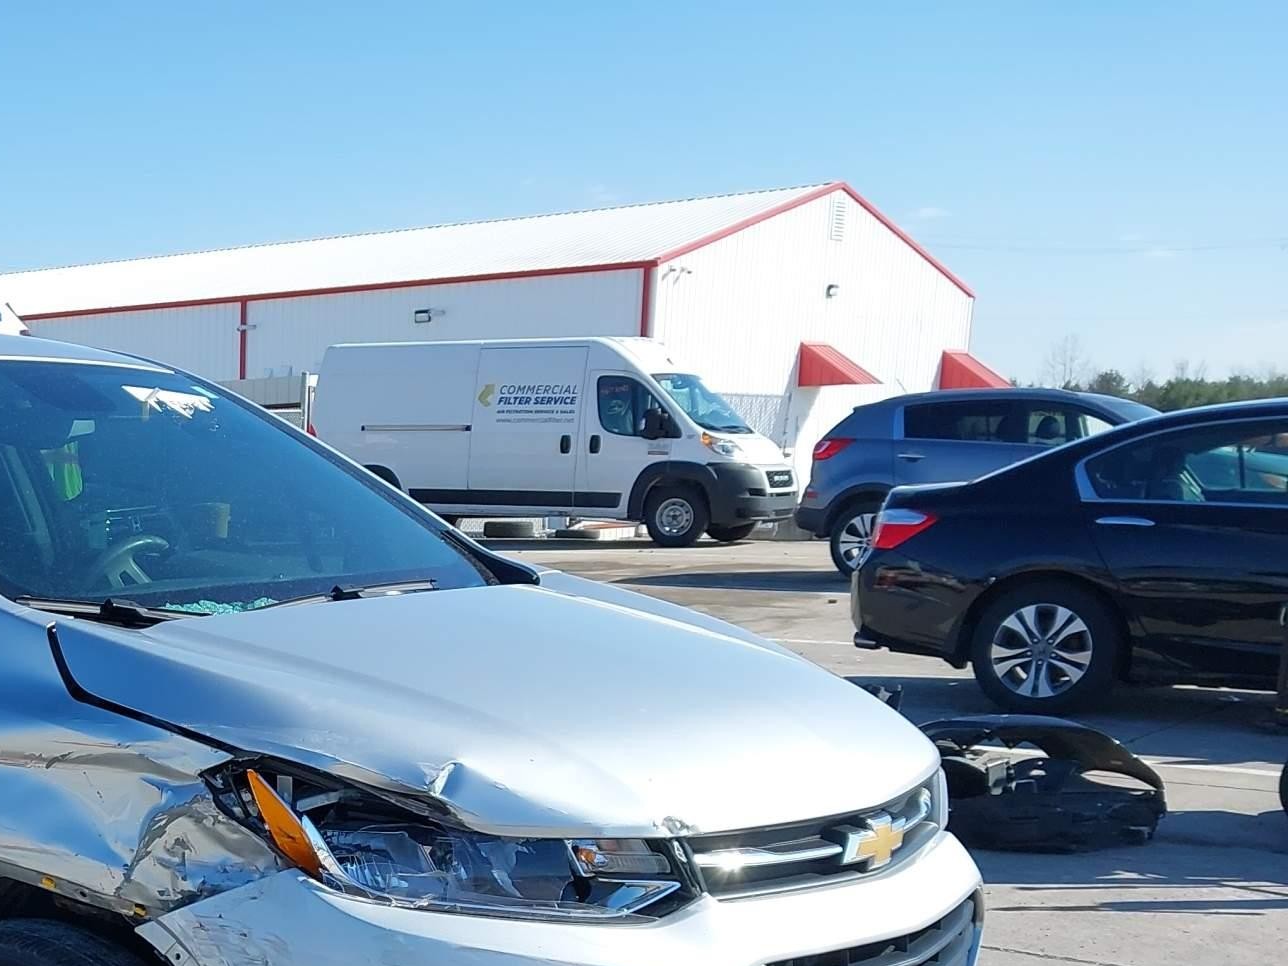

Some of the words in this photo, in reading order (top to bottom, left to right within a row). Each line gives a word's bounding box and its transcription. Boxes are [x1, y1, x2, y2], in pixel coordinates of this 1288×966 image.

[500, 385, 578, 395] COMMERCIAL
[498, 396, 532, 405] FILTER
[533, 396, 577, 405] SERVICE
